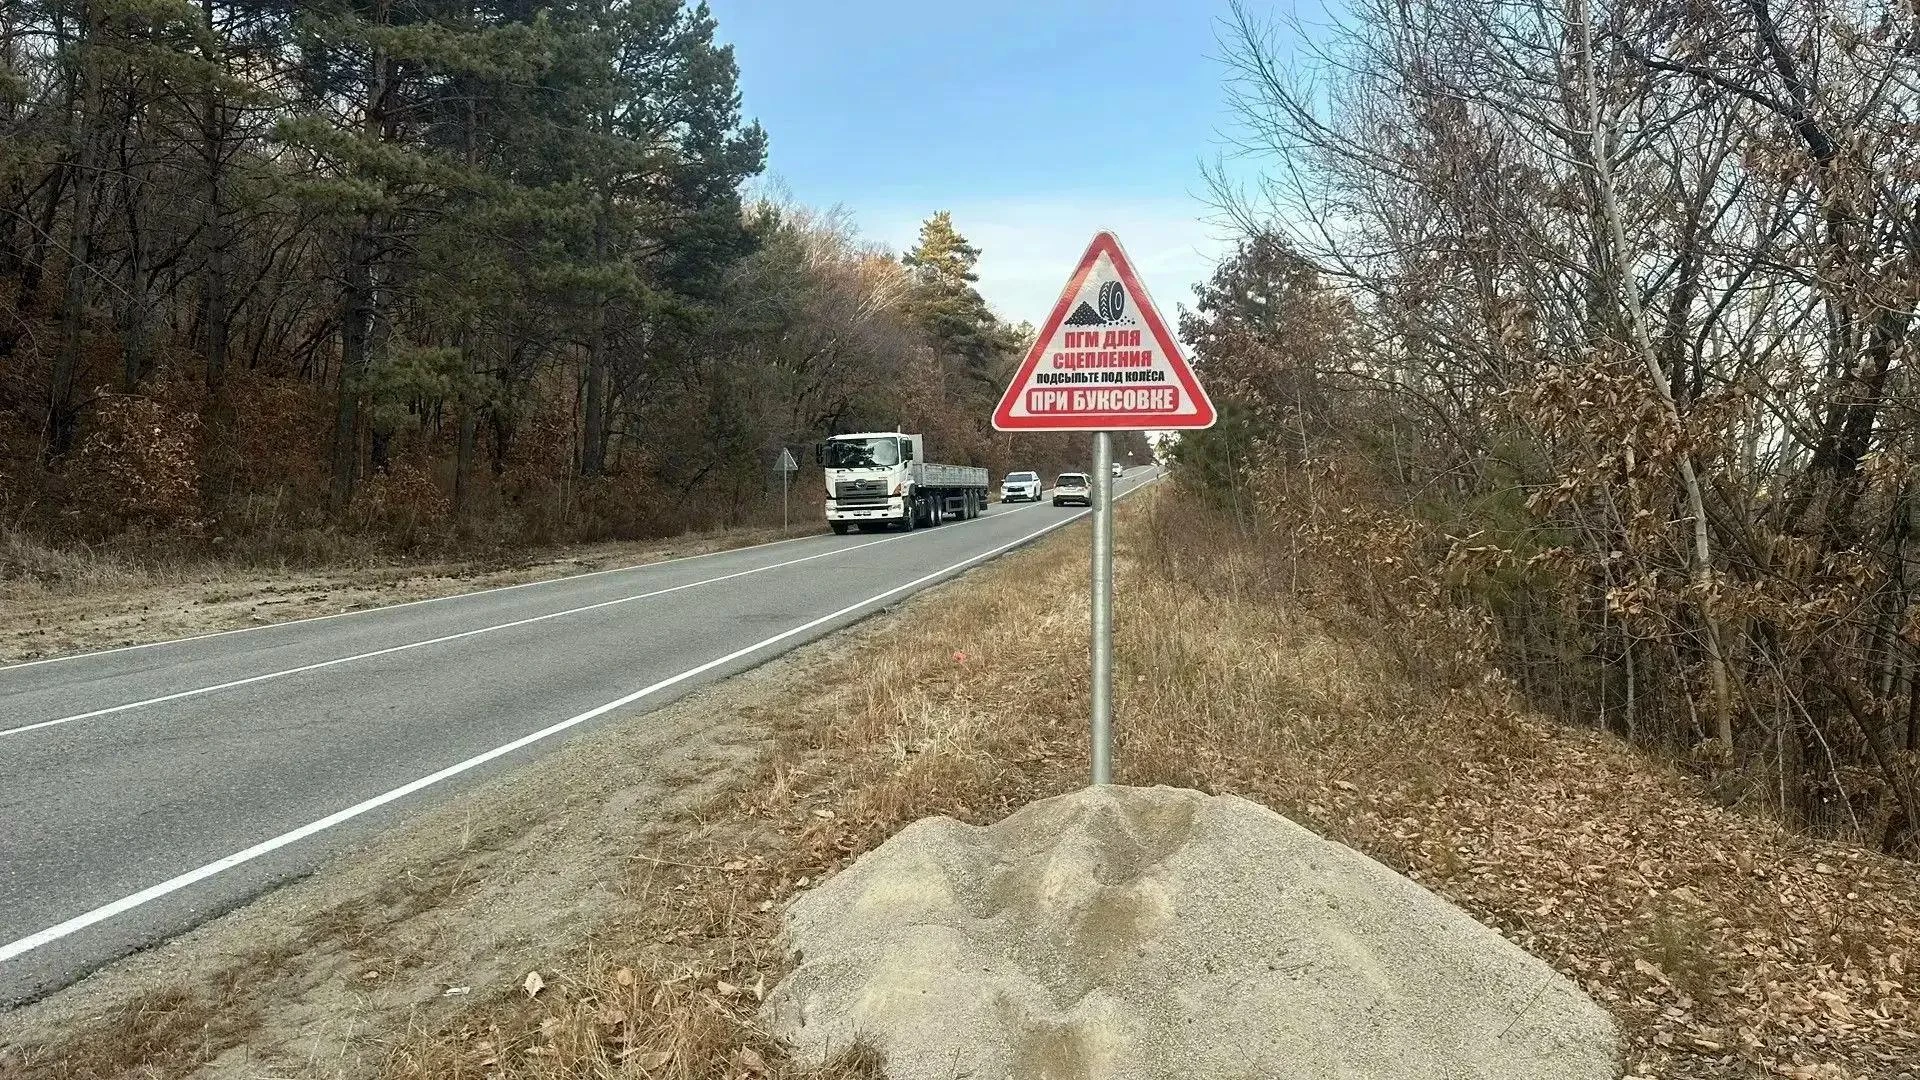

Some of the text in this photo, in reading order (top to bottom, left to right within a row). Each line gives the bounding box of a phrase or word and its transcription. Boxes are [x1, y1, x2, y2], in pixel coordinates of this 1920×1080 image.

[1064, 330, 1141, 349] ПГМ ДЛЯ
[1053, 351, 1152, 370] СЦЕПЛЕНИЯ
[1036, 370, 1165, 384] ПОДСЫПЬТЕ ПОД КОЛЁСА
[1031, 389, 1174, 411] ПРИ БУКСОВКЕ
